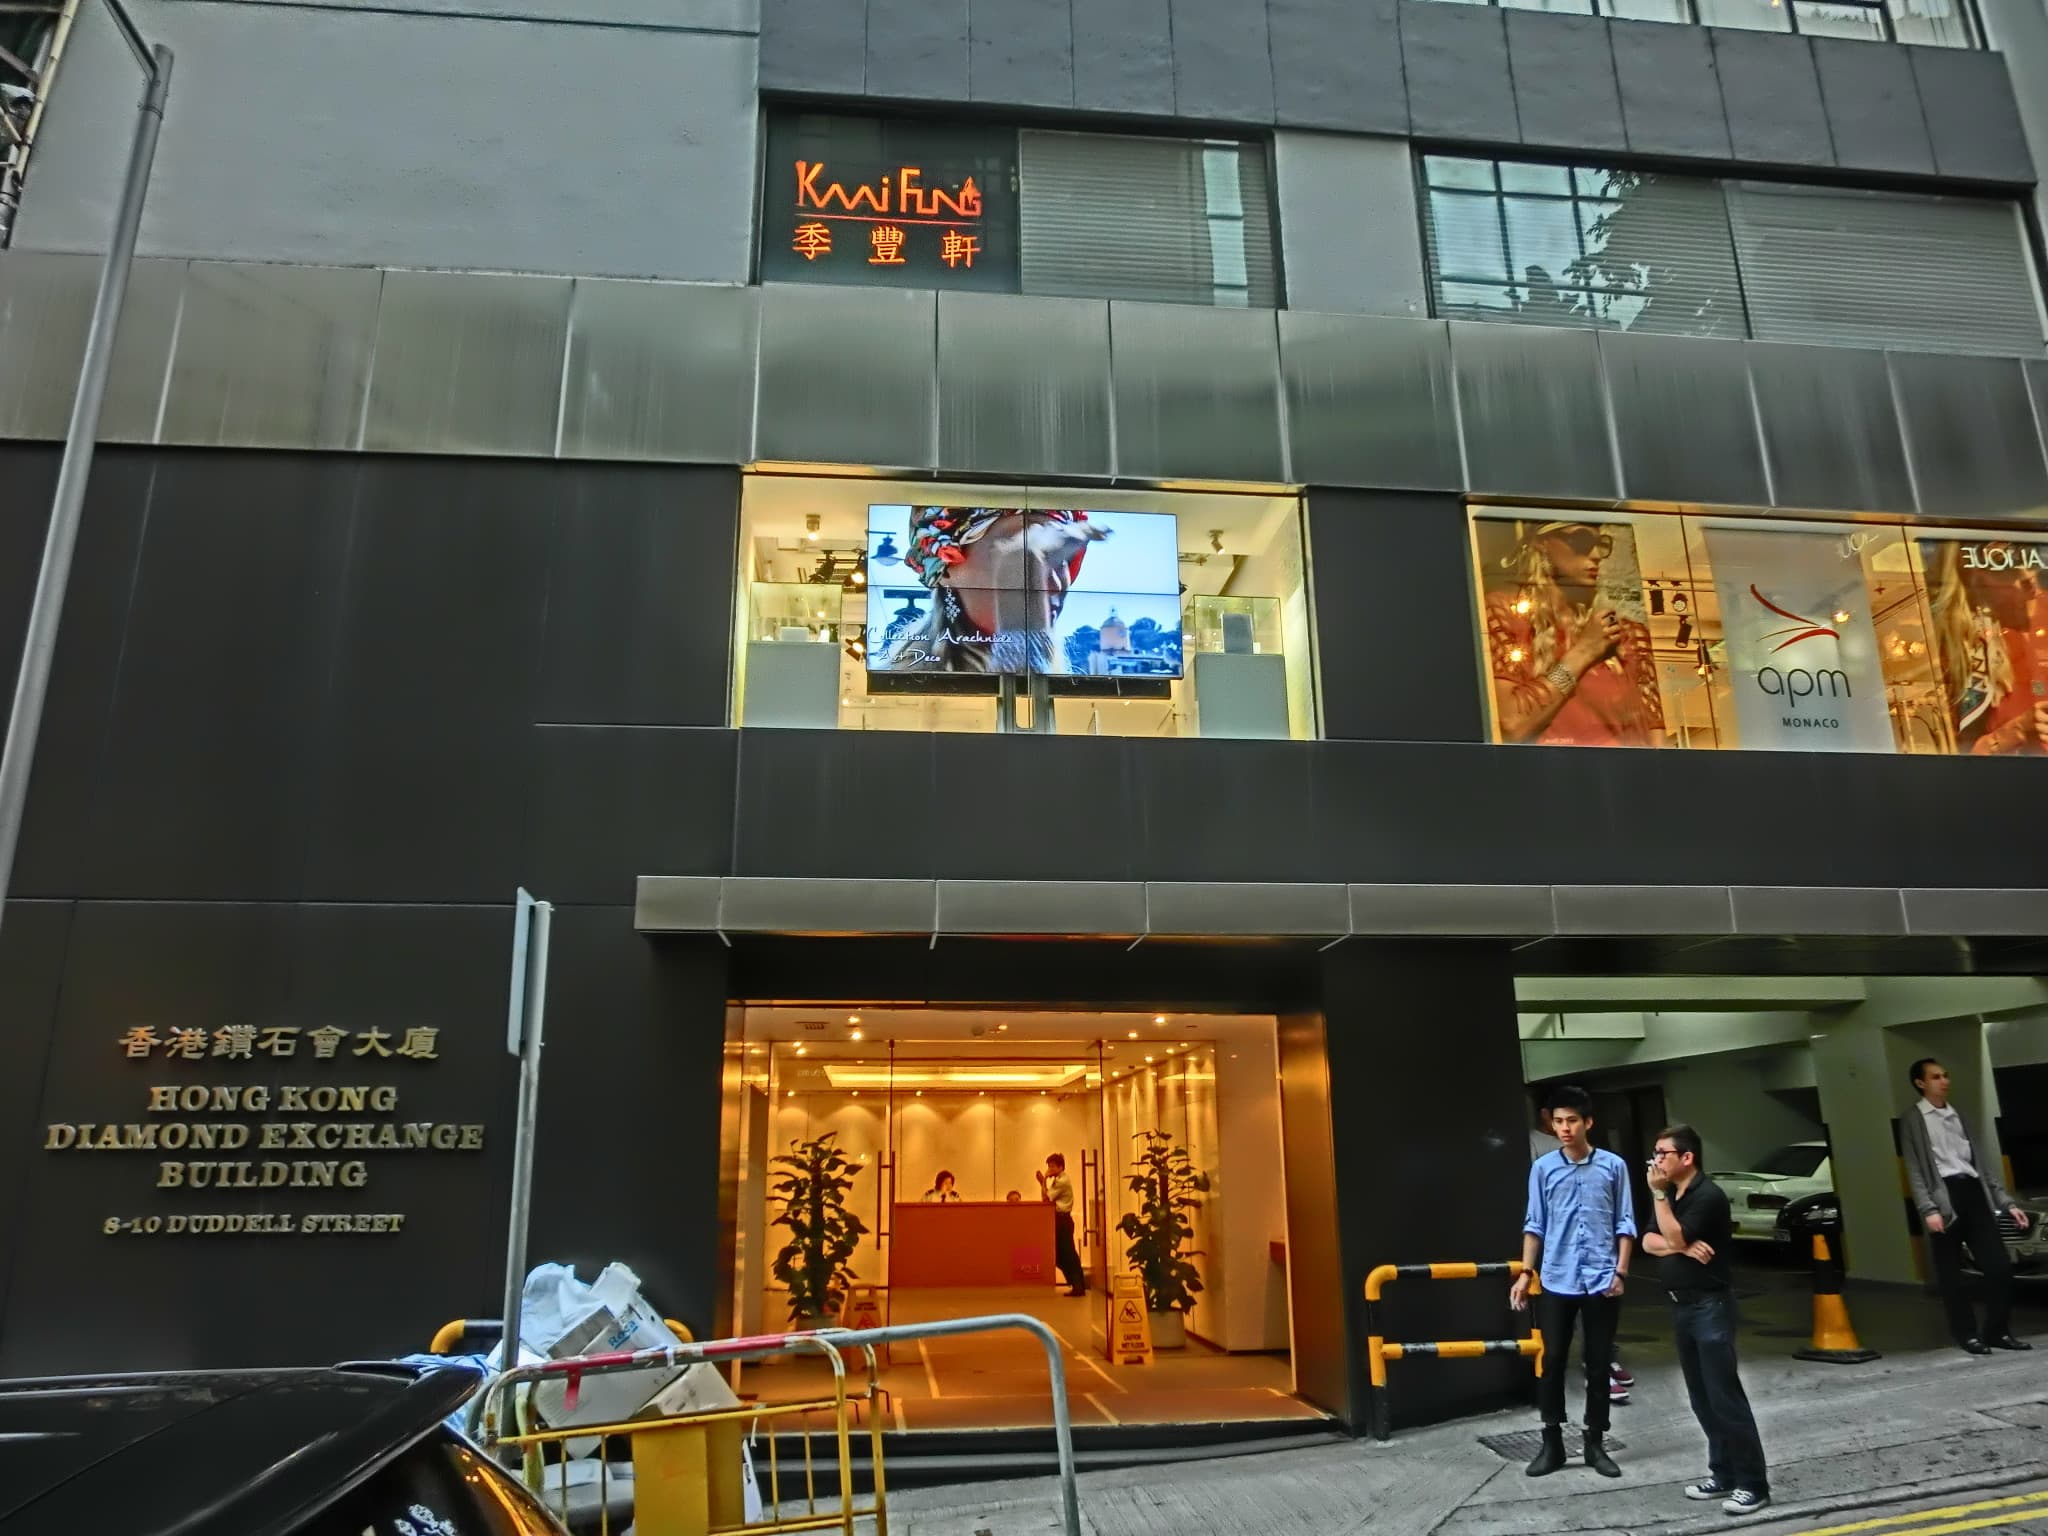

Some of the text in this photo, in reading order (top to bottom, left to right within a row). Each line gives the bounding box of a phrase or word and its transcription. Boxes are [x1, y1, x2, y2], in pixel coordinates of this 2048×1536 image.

[792, 222, 982, 268] 季豐軒
[907, 648, 941, 667] Deco
[1757, 666, 1852, 708] apm
[1782, 717, 1839, 729] MONACO
[118, 1024, 441, 1060] 香港鑽石會大廈
[147, 1085, 399, 1112] HONG KONG
[44, 1122, 485, 1150] DIAMOND EXCHANGE
[156, 1160, 368, 1188] BUILDING
[103, 1214, 405, 1234] 8-10 DUDDELL STREET
[607, 1320, 639, 1348] Roca
